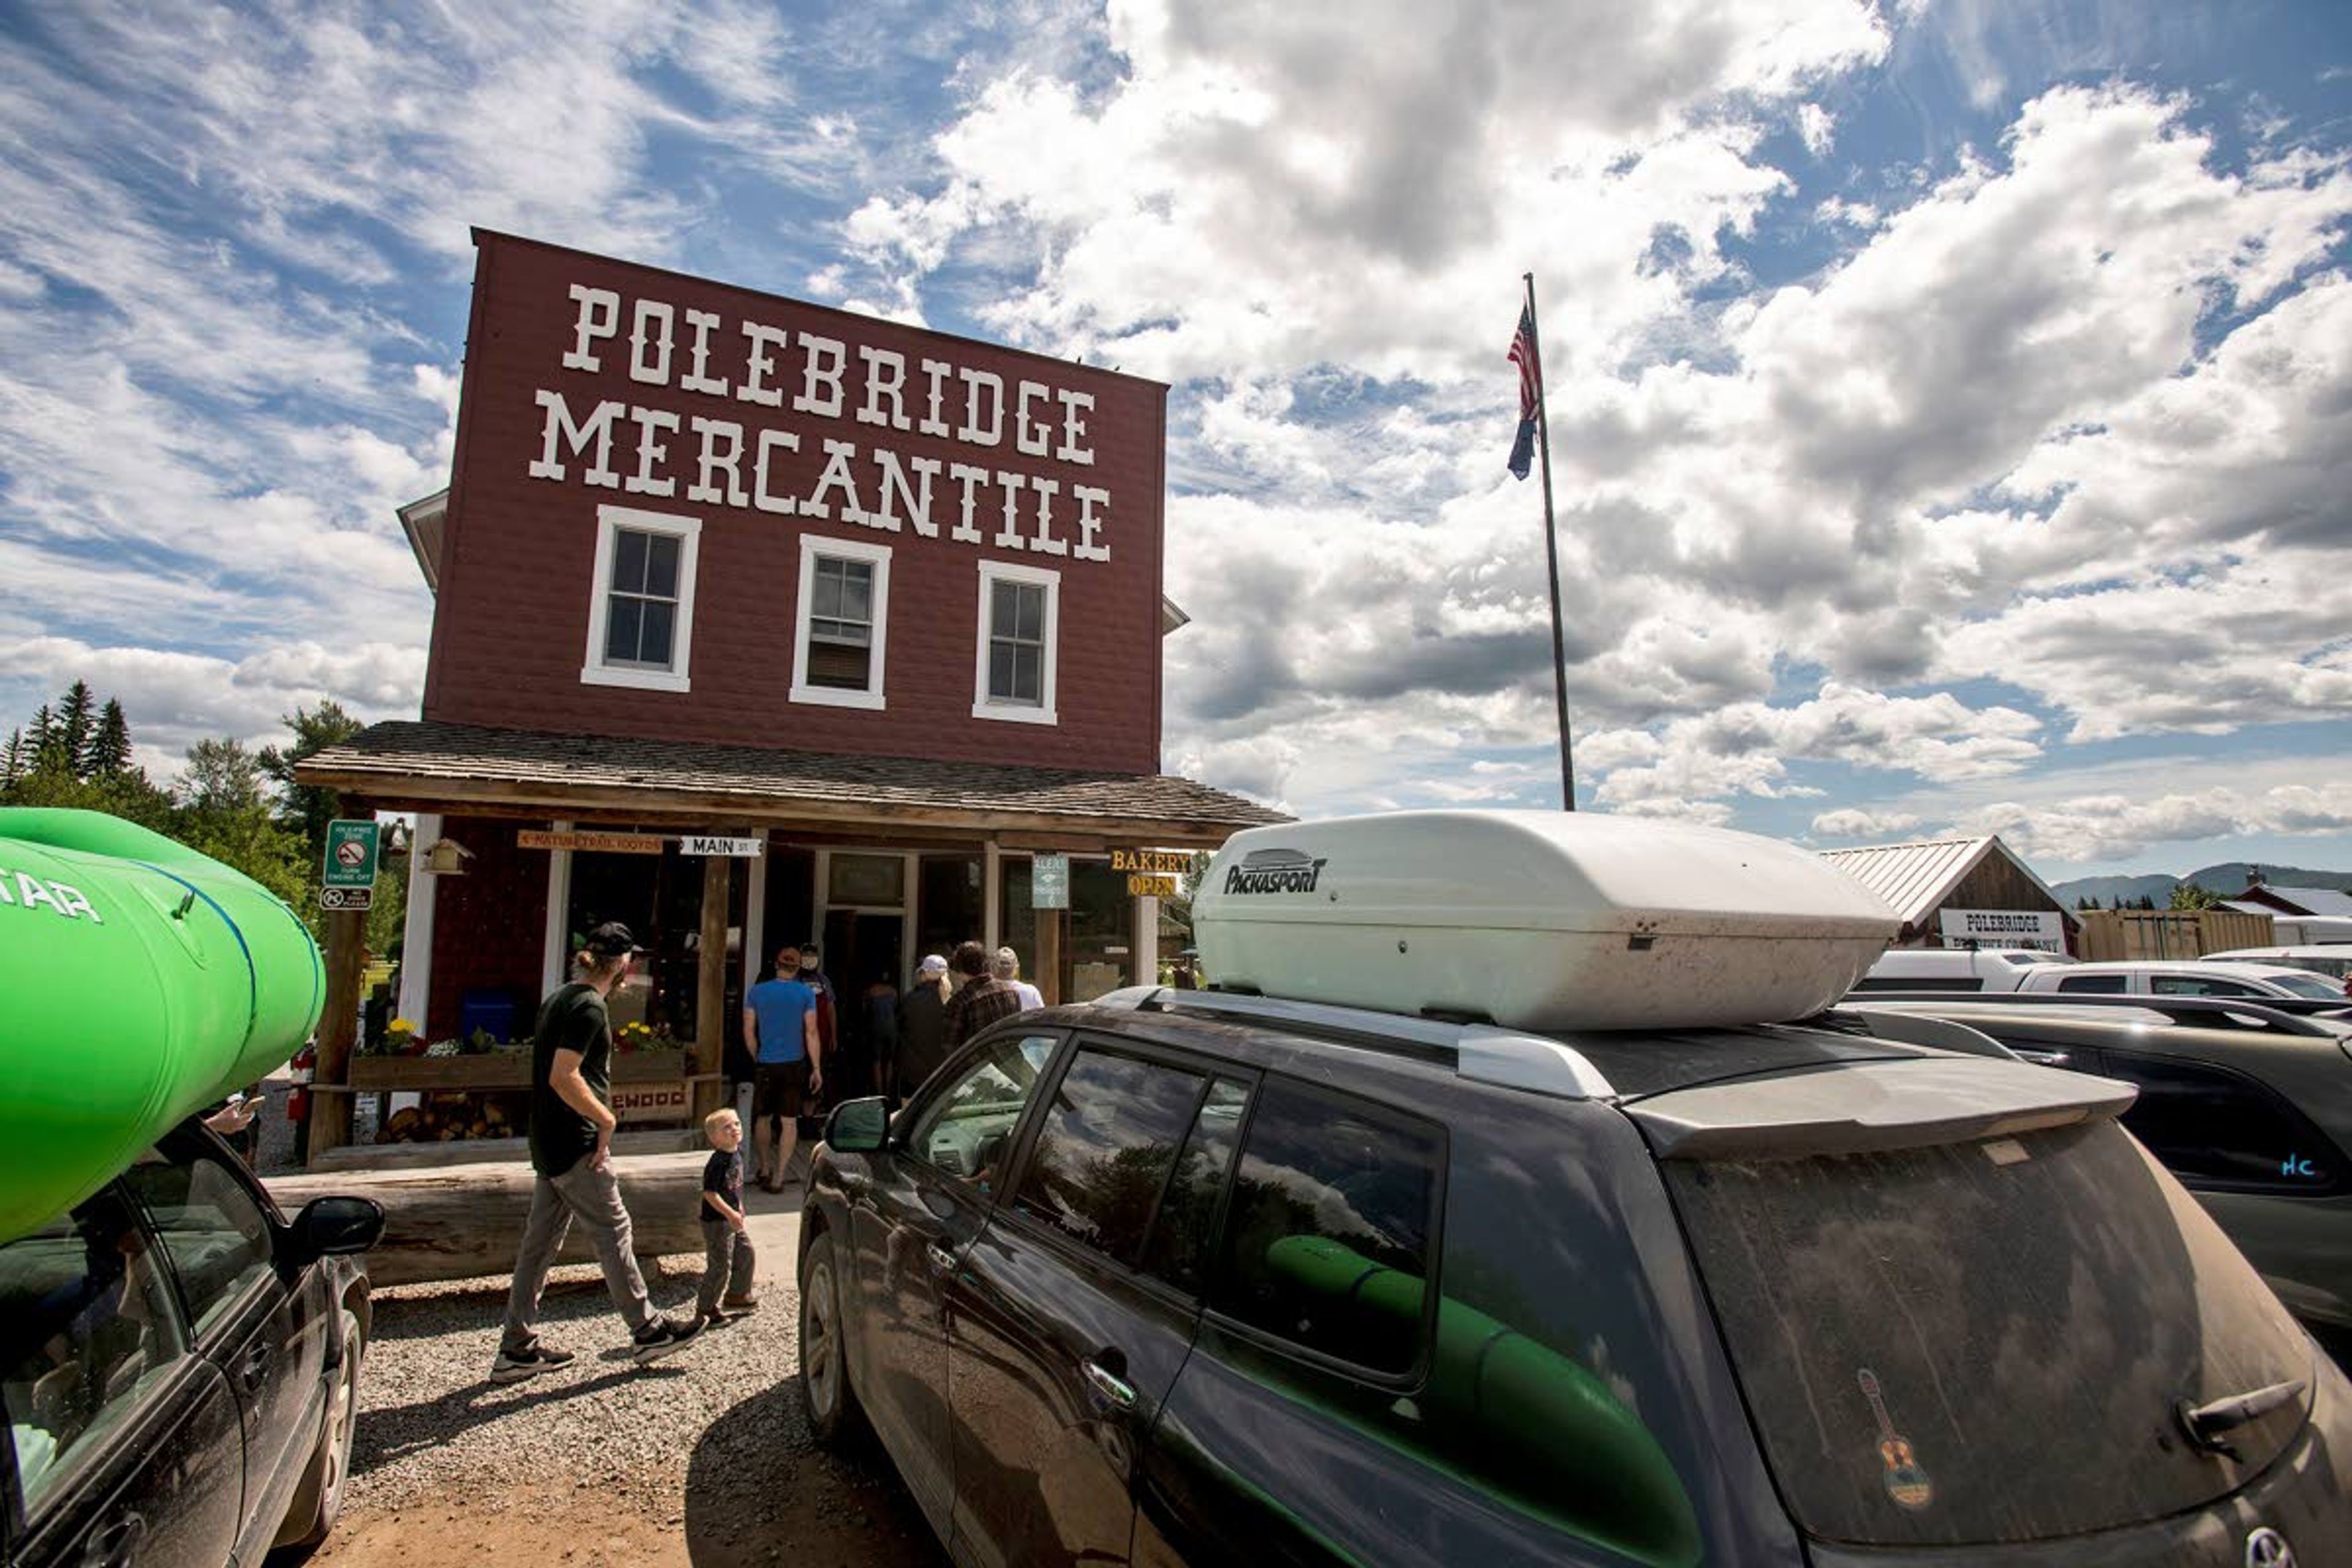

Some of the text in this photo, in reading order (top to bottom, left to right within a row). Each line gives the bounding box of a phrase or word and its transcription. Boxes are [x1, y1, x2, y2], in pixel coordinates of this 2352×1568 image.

[562, 282, 1096, 465] POLEBRIDGE
[529, 390, 1111, 562] MERCANTILE
[694, 839, 734, 853] MAIN
[1112, 850, 1189, 871] BAKERY
[1129, 876, 1174, 895] OPEN
[1224, 858, 1327, 894] PACKASPORT
[1966, 913, 2040, 932] POLEBRIDGE
